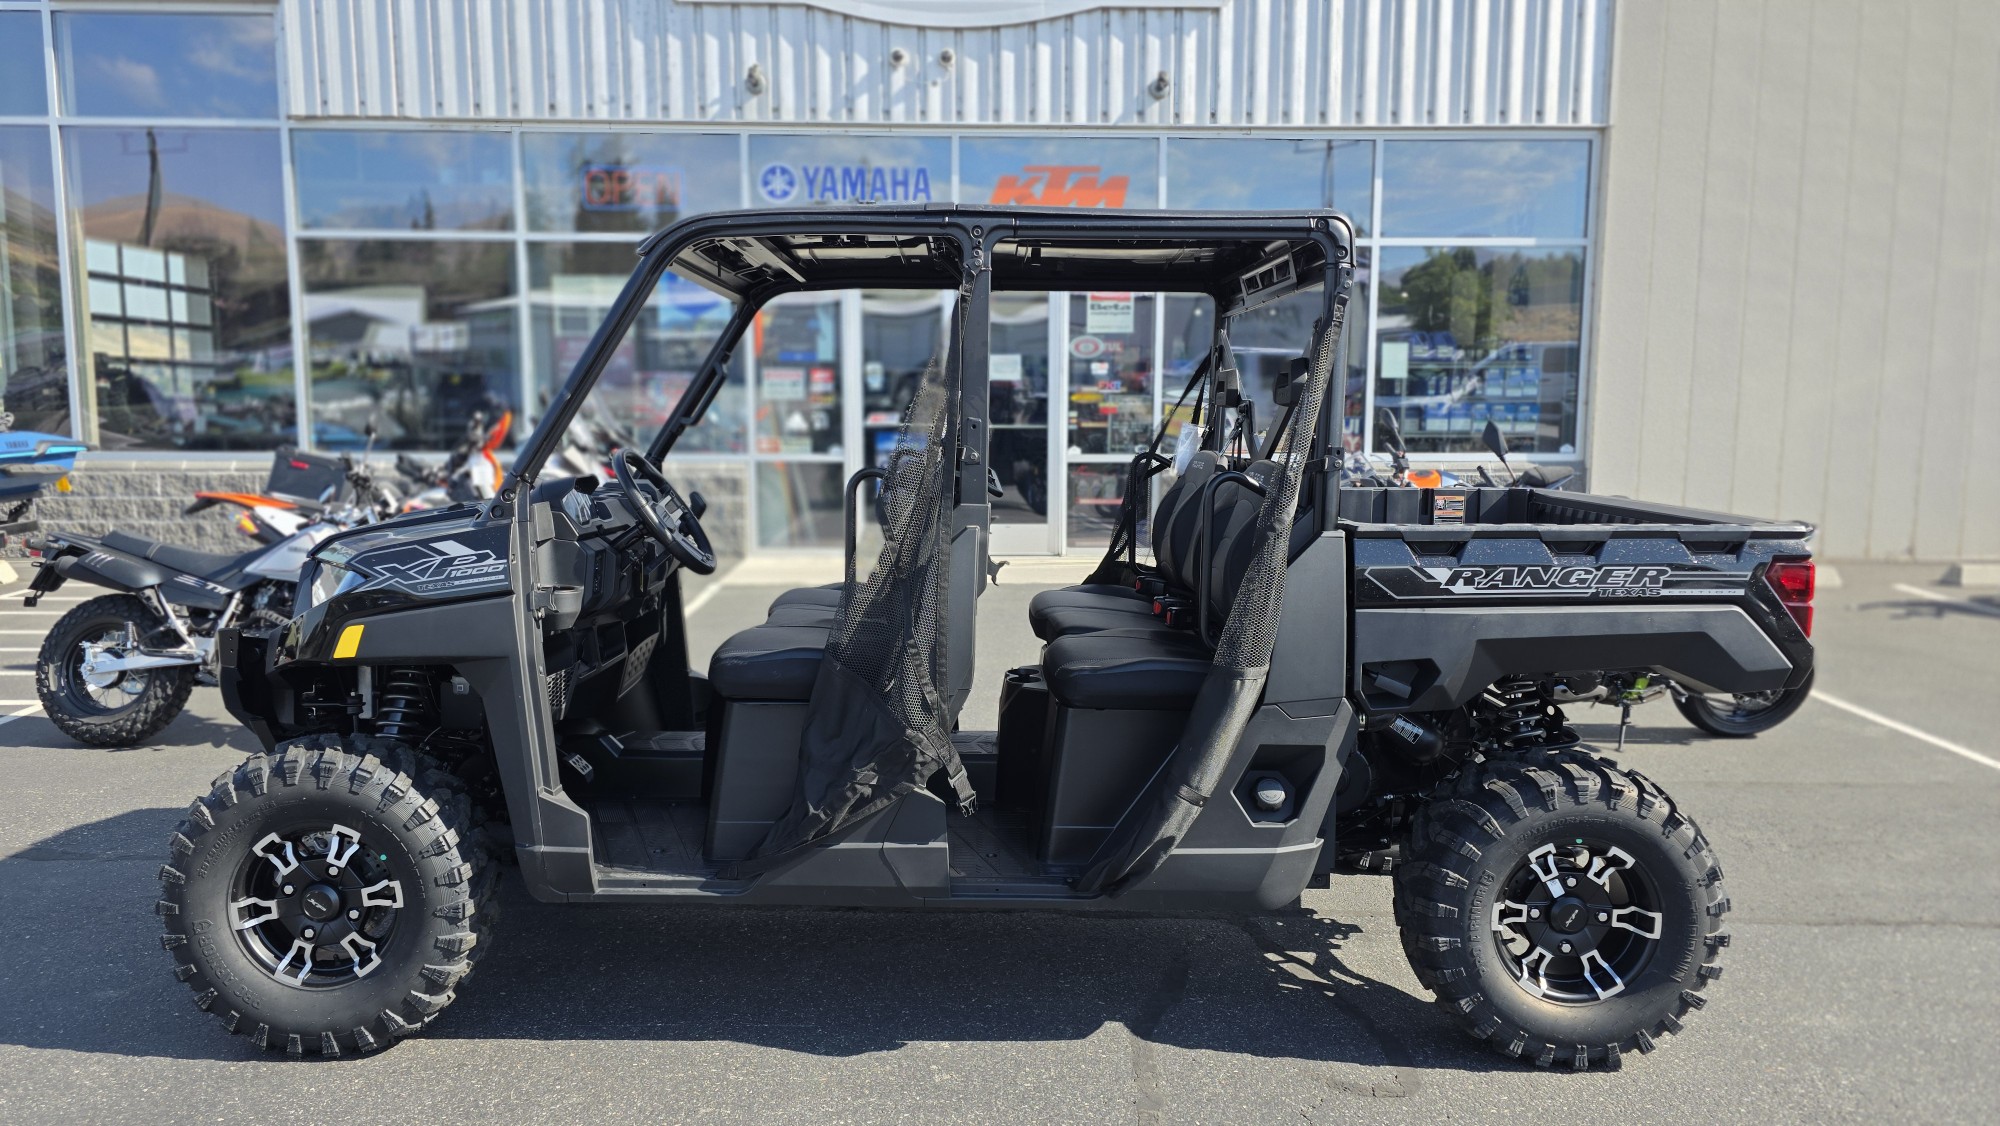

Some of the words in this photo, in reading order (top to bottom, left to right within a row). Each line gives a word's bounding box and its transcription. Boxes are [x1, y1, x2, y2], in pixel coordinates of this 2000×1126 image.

[585, 170, 682, 206] OPEN
[802, 166, 932, 201] YAMAHA
[989, 165, 1130, 208] KTM
[1089, 303, 1131, 311] Beta
[352, 549, 497, 593] XP
[449, 564, 505, 578] 1000
[1440, 566, 1671, 588] RANGER
[417, 580, 455, 591] TEXAS
[1599, 587, 1663, 597] TEXAS
